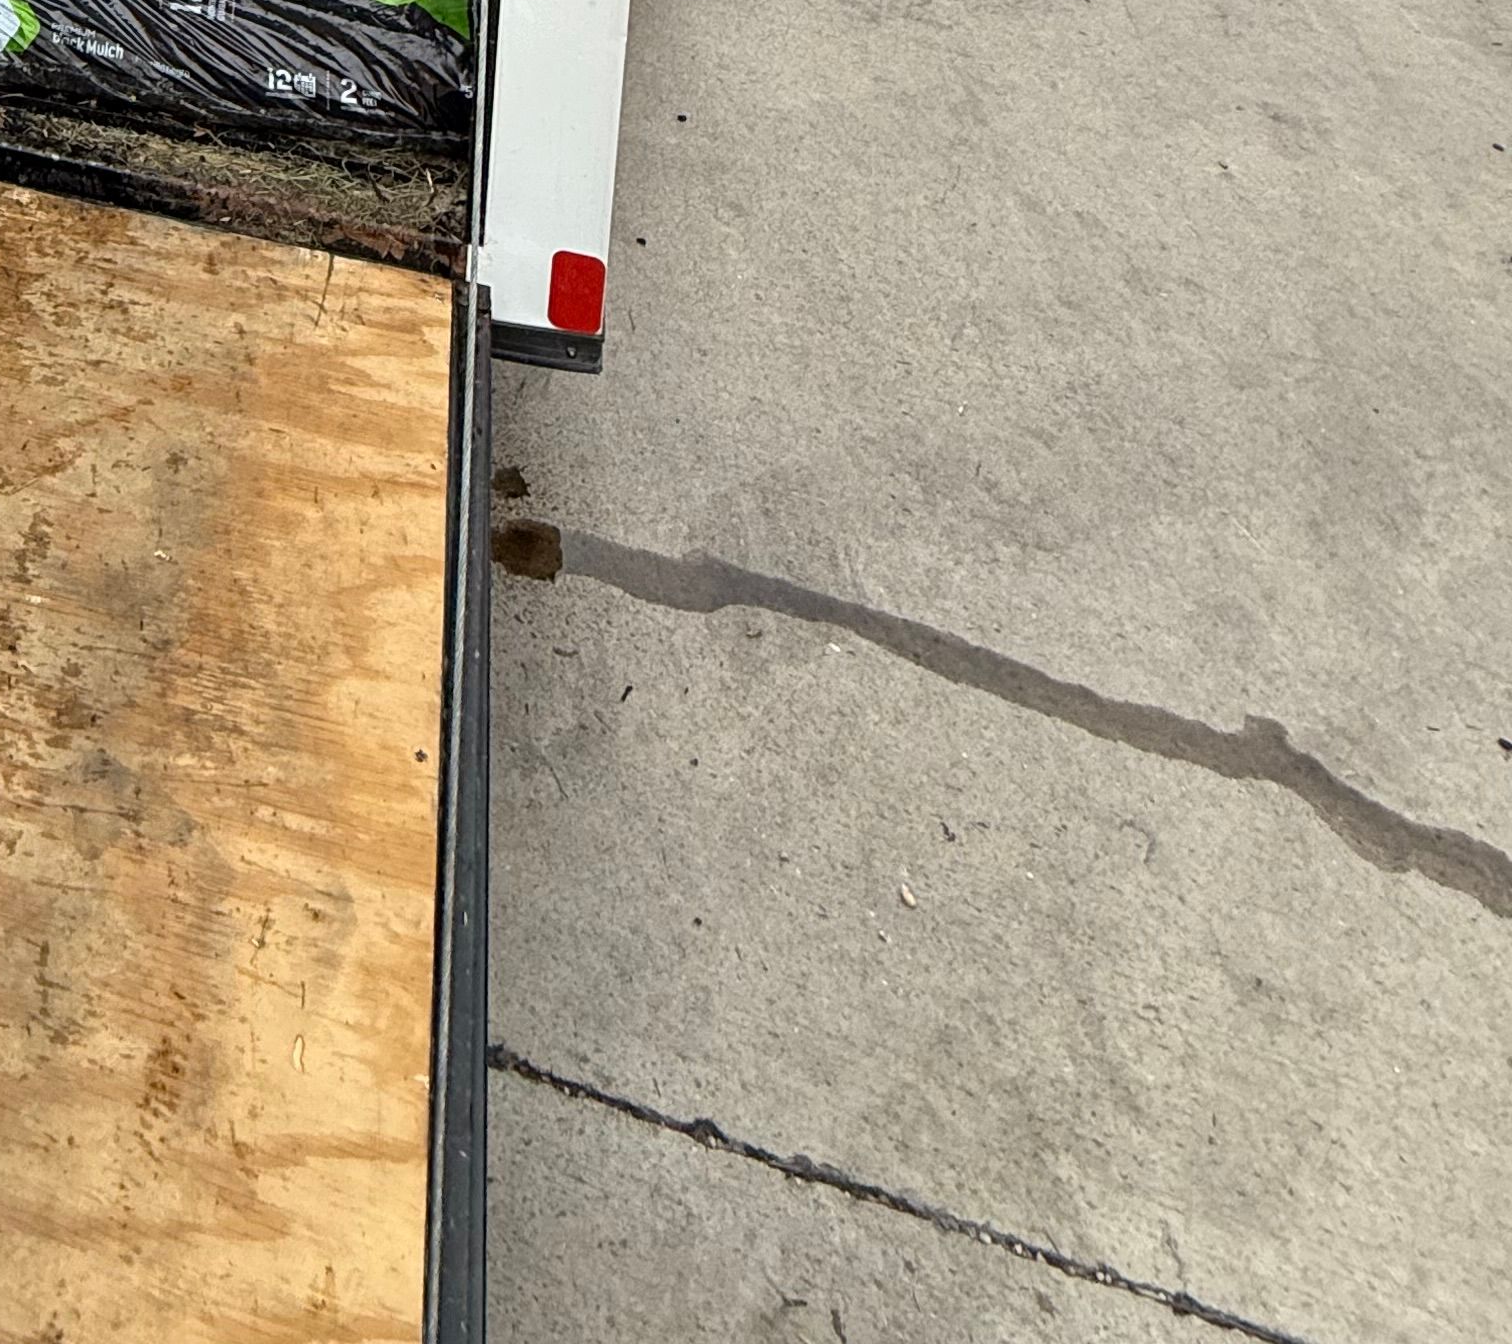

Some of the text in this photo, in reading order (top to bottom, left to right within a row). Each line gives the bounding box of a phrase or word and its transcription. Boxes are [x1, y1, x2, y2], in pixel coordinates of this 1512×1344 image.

[51, 21, 97, 39] PREMIUM
[86, 39, 125, 61] Mulch
[267, 66, 358, 105] 12 2
